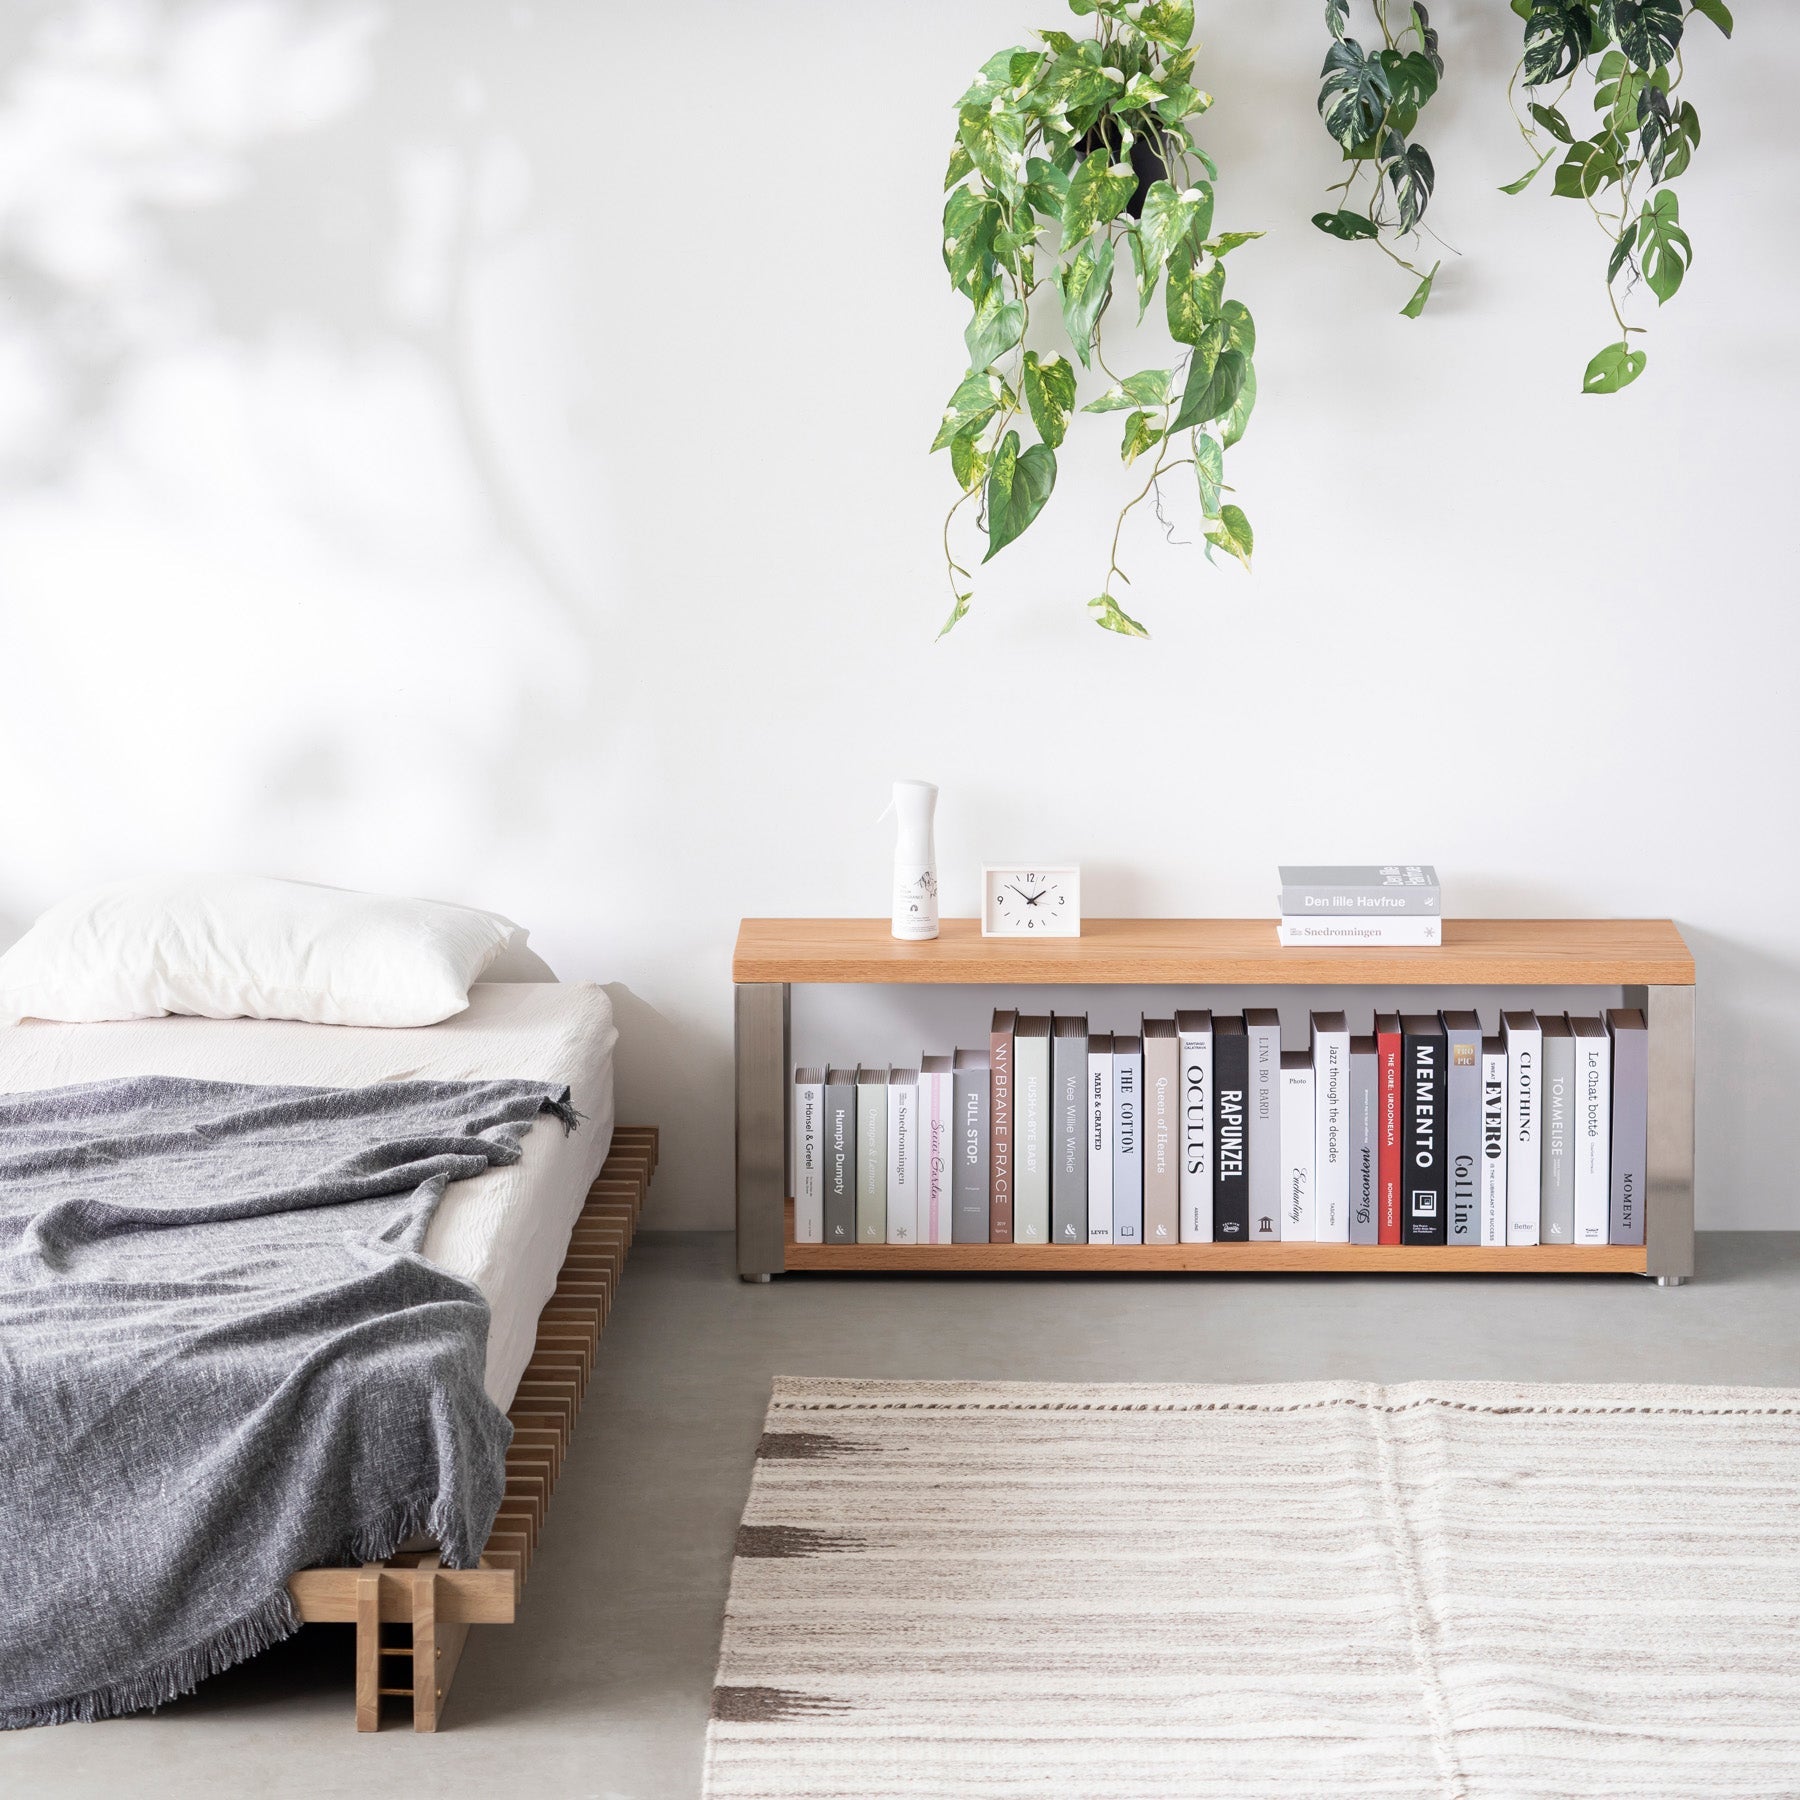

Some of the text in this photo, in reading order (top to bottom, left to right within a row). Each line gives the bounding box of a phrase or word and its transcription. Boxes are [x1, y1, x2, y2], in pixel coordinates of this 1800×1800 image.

[997, 896, 1004, 905] 9
[1026, 873, 1034, 882] 12
[1058, 896, 1065, 905] 3
[1304, 896, 1406, 907] Den lille Havfrue
[1028, 920, 1034, 928] 6
[1304, 927, 1382, 938] Snedronningen
[1121, 1068, 1133, 1154] THE COTTON
[1259, 1037, 1269, 1120] LINA BO BARDI
[1327, 1046, 1339, 1163] Jazz through the decades
[1416, 1046, 1433, 1168] MEMENTO
[1520, 1052, 1531, 1142] CLOTHING
[1552, 1077, 1563, 1156] TOMMELISE
[1588, 1052, 1598, 1137] Le Chat botté
[805, 1144, 813, 1170] Gretel
[834, 1110, 845, 1195] Humpty Dumpty
[867, 1108, 878, 1194] Oranges & Lemons
[898, 1107, 907, 1185] Snedronningen
[966, 1094, 978, 1166] FULL STOP.
[996, 1043, 1007, 1204] WYBRANE PRACE
[1027, 1145, 1037, 1173] BABY
[1066, 1076, 1076, 1173] Wee Willie Winkie
[1157, 1077, 1168, 1174] Queen of Hearts
[1186, 1065, 1204, 1174] OCULUS
[1221, 1090, 1242, 1181] RAPUNZEL
[1485, 1081, 1502, 1159] EVERO
[931, 1156, 944, 1200] Garden
[1357, 1147, 1370, 1224] Discontent
[1454, 1155, 1474, 1234] Collins
[1622, 1173, 1633, 1229] MOMENT
